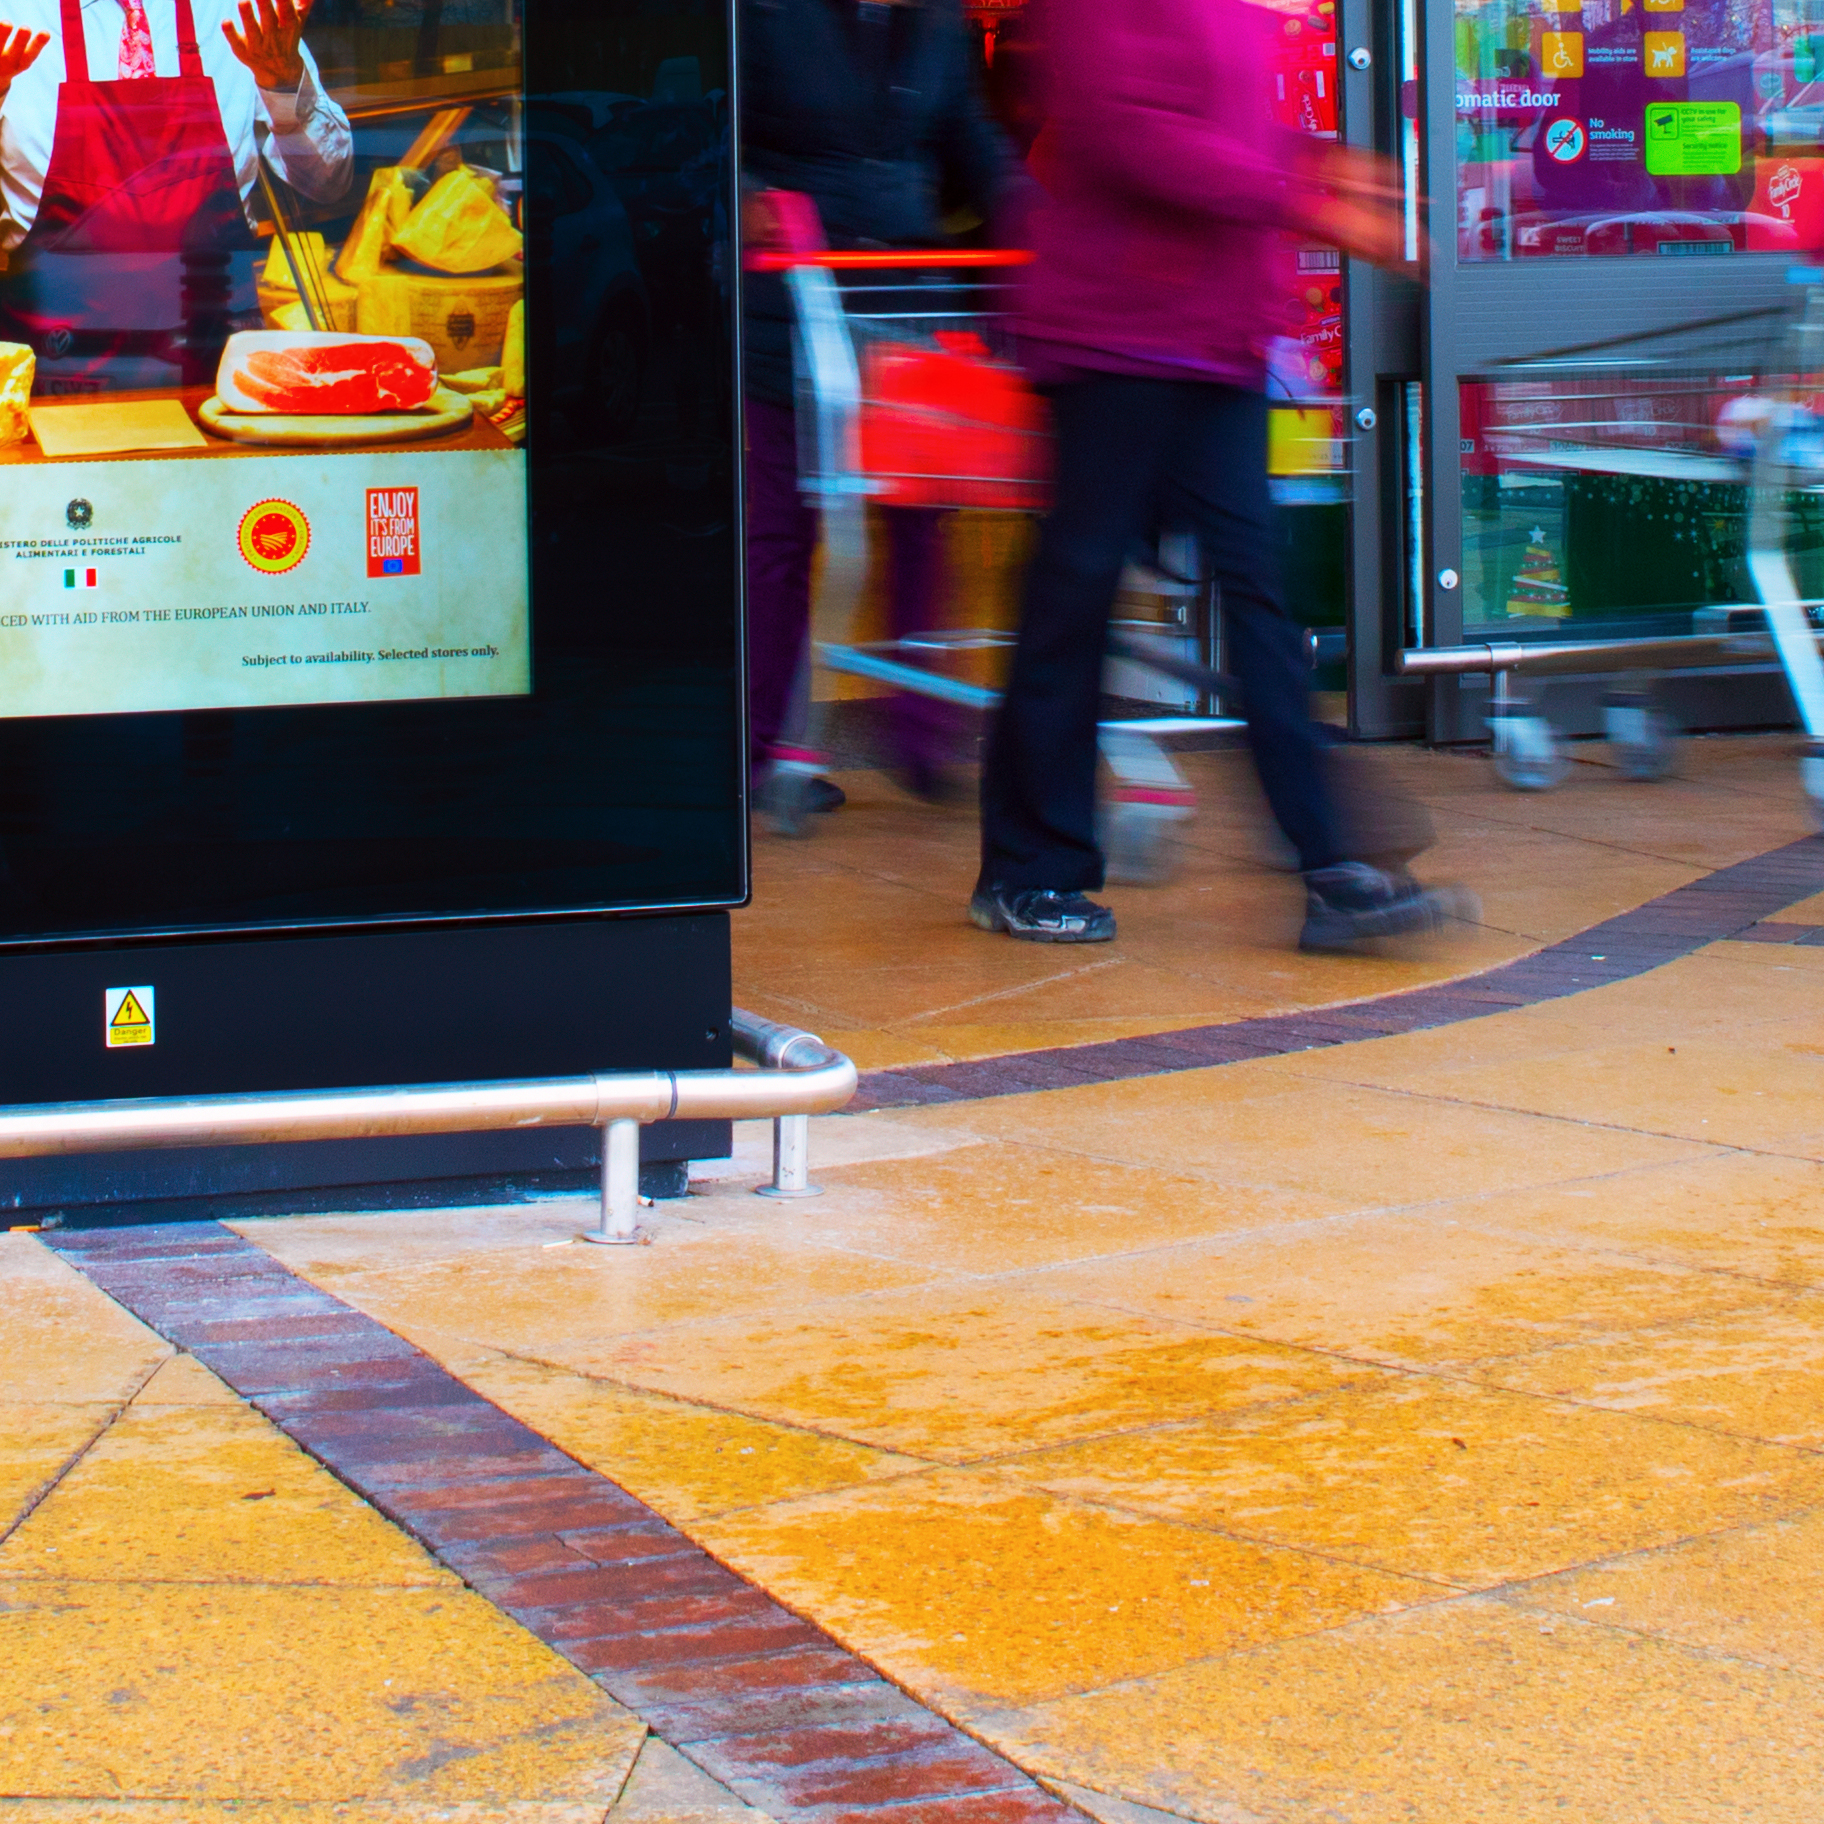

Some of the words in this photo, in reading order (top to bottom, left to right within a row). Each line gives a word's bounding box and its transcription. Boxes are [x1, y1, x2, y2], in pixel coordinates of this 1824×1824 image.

[1519, 88, 1562, 107] door
[1589, 118, 1604, 128] No
[1589, 128, 1635, 141] smoking
[370, 491, 415, 519] ENJOY
[370, 518, 388, 536] IT'S
[389, 517, 415, 535] FROM
[40, 538, 70, 547] DELLE
[72, 536, 129, 546] POLITICHE
[132, 535, 182, 544] AGRICOLE
[370, 535, 415, 558] EUROPE
[15, 548, 78, 558] ALIMENTARI
[91, 546, 146, 556] FORESTALI
[31, 613, 70, 626] WITH
[73, 612, 98, 624] AID
[101, 610, 140, 623] FROM
[143, 609, 171, 621] THE
[175, 605, 248, 621] EUROPEAN
[251, 604, 295, 617] UNION
[298, 603, 327, 616] AND
[330, 601, 372, 615] ITALY.
[241, 653, 287, 668] Subject
[290, 654, 303, 665] to
[305, 650, 376, 666] availability.
[377, 647, 429, 662] Selected
[431, 647, 469, 659] stores
[471, 644, 500, 660] only.
[114, 1028, 147, 1036] Danger
